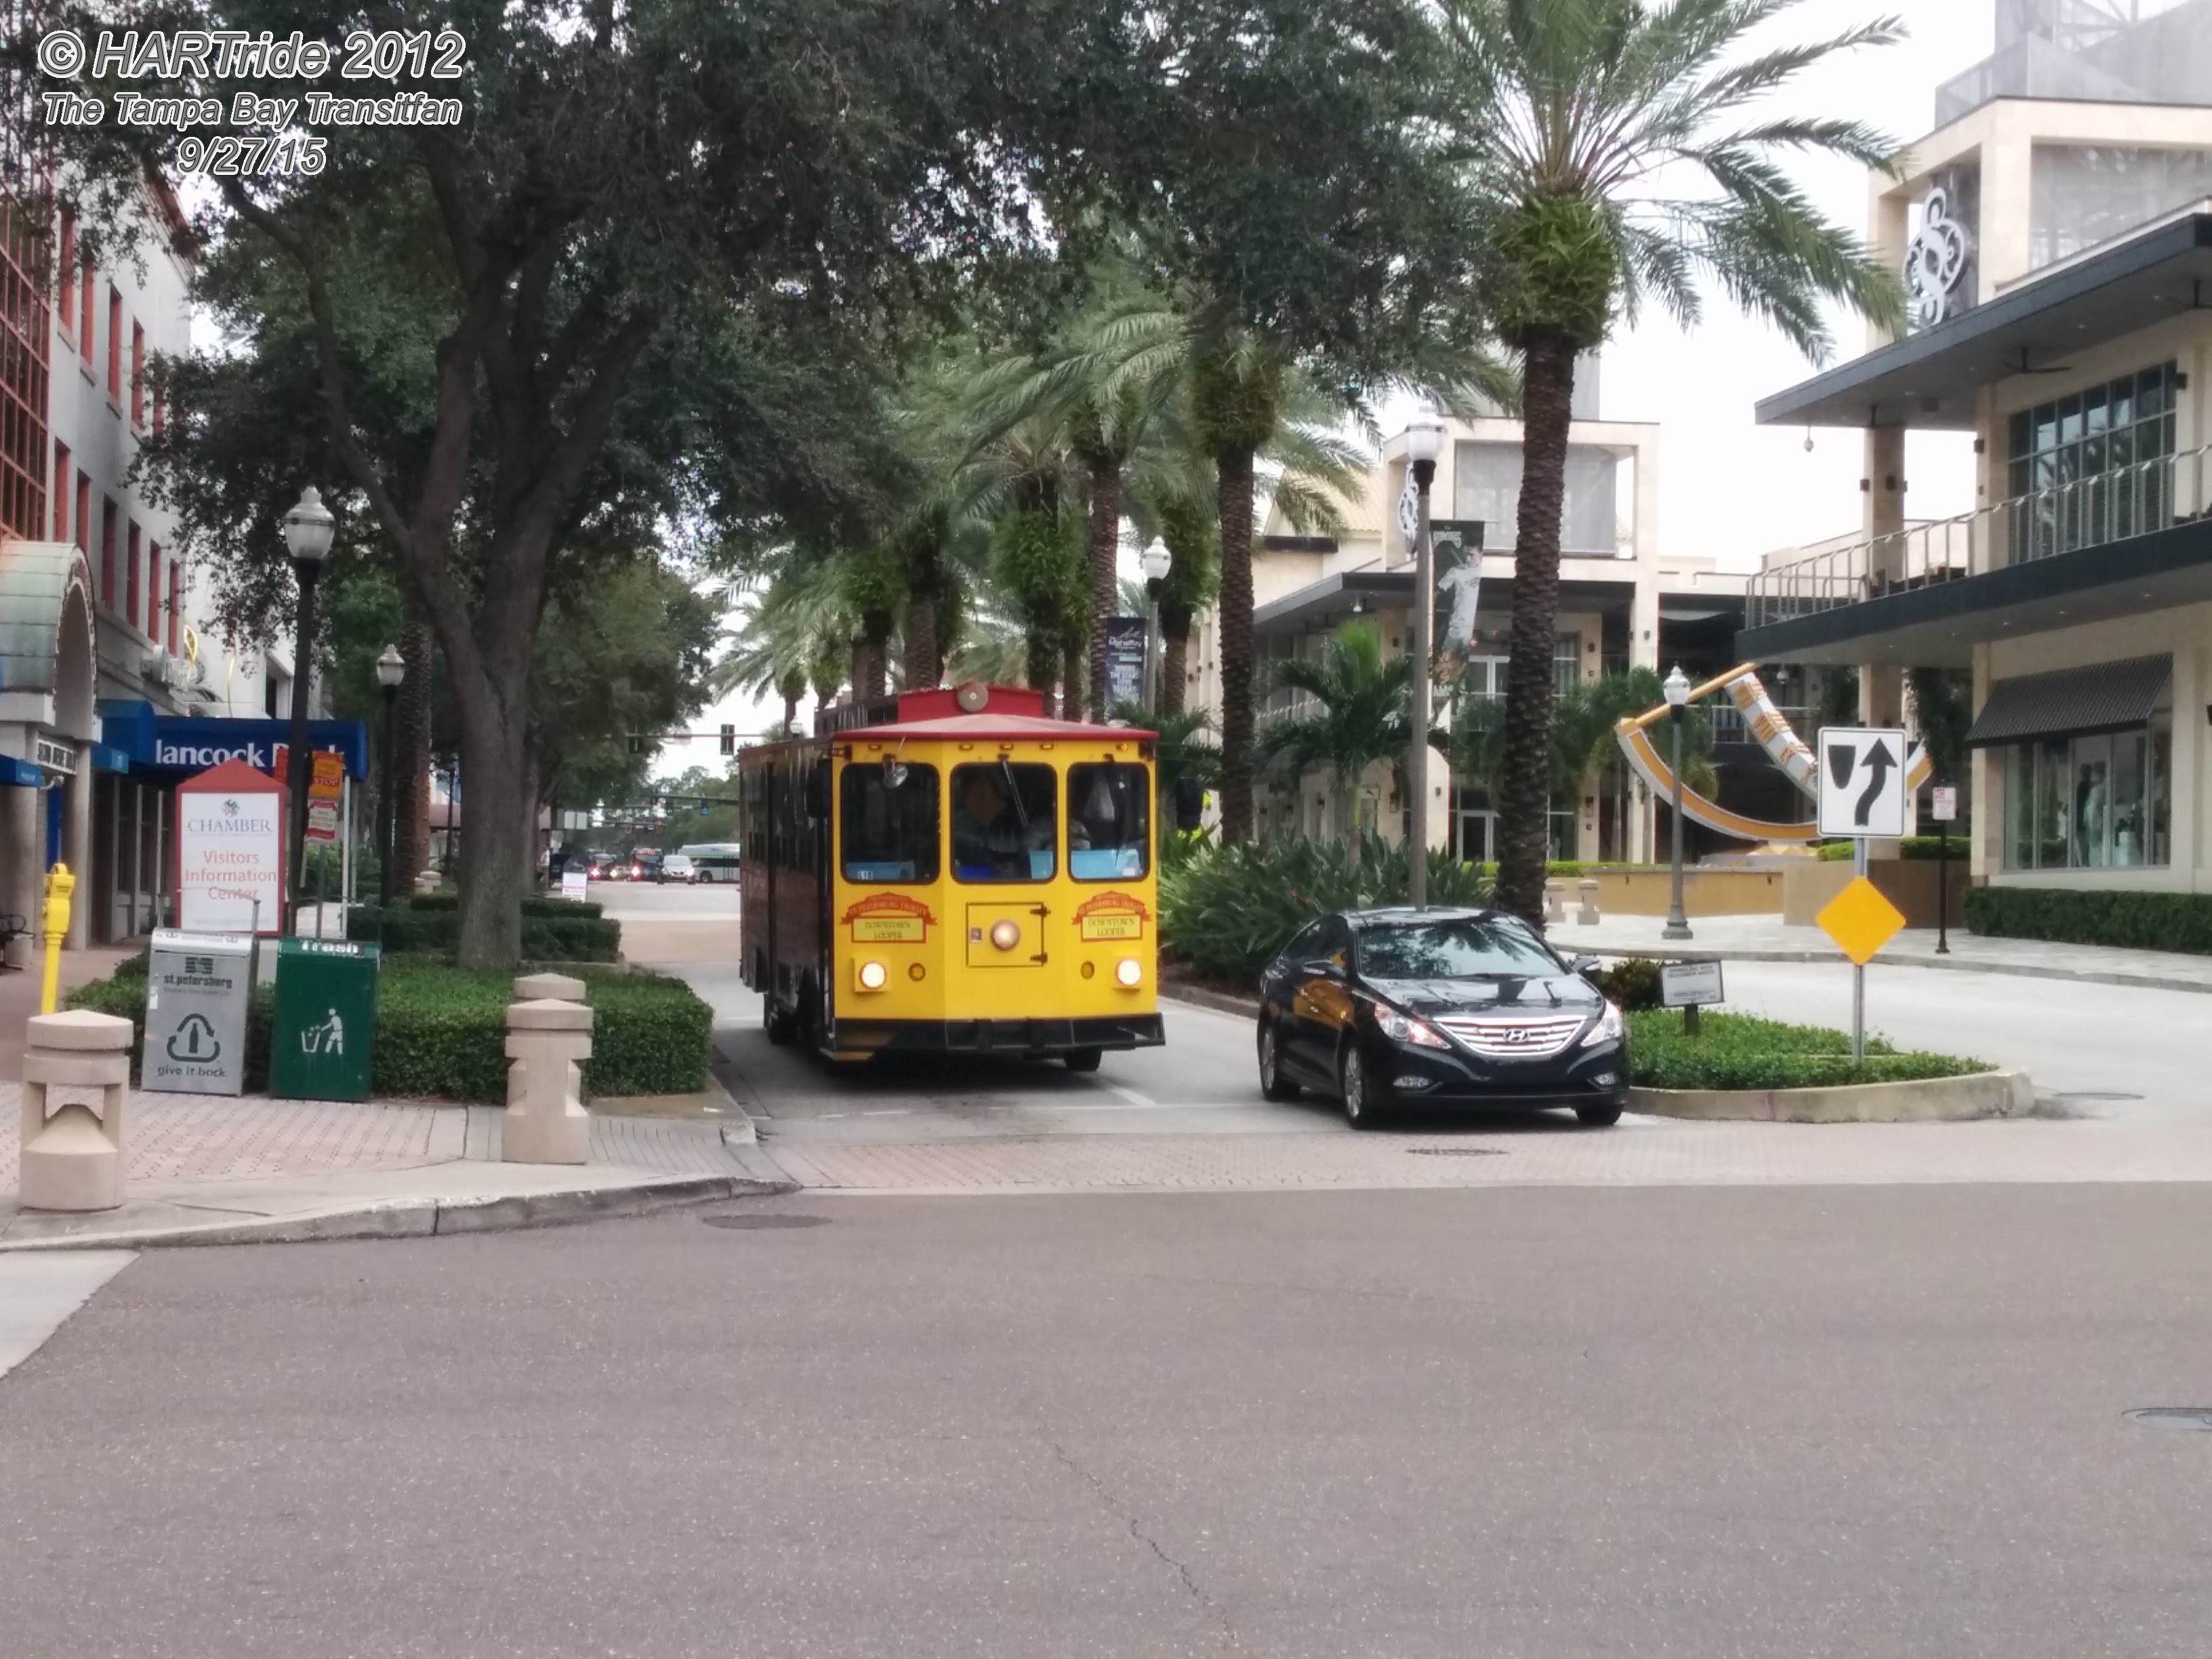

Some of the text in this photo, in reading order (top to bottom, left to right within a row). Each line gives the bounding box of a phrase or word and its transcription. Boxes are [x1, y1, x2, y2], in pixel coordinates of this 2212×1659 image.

[188, 819, 272, 833] CHAMBER
[203, 851, 260, 864] Visitors
[185, 867, 276, 882] Information
[208, 886, 260, 900] Center
[865, 921, 911, 929] DOWNTOWN
[1088, 917, 1135, 927] DOWNTOWN
[1097, 928, 1126, 937] LOOPER
[157, 1065, 226, 1077] give it back
